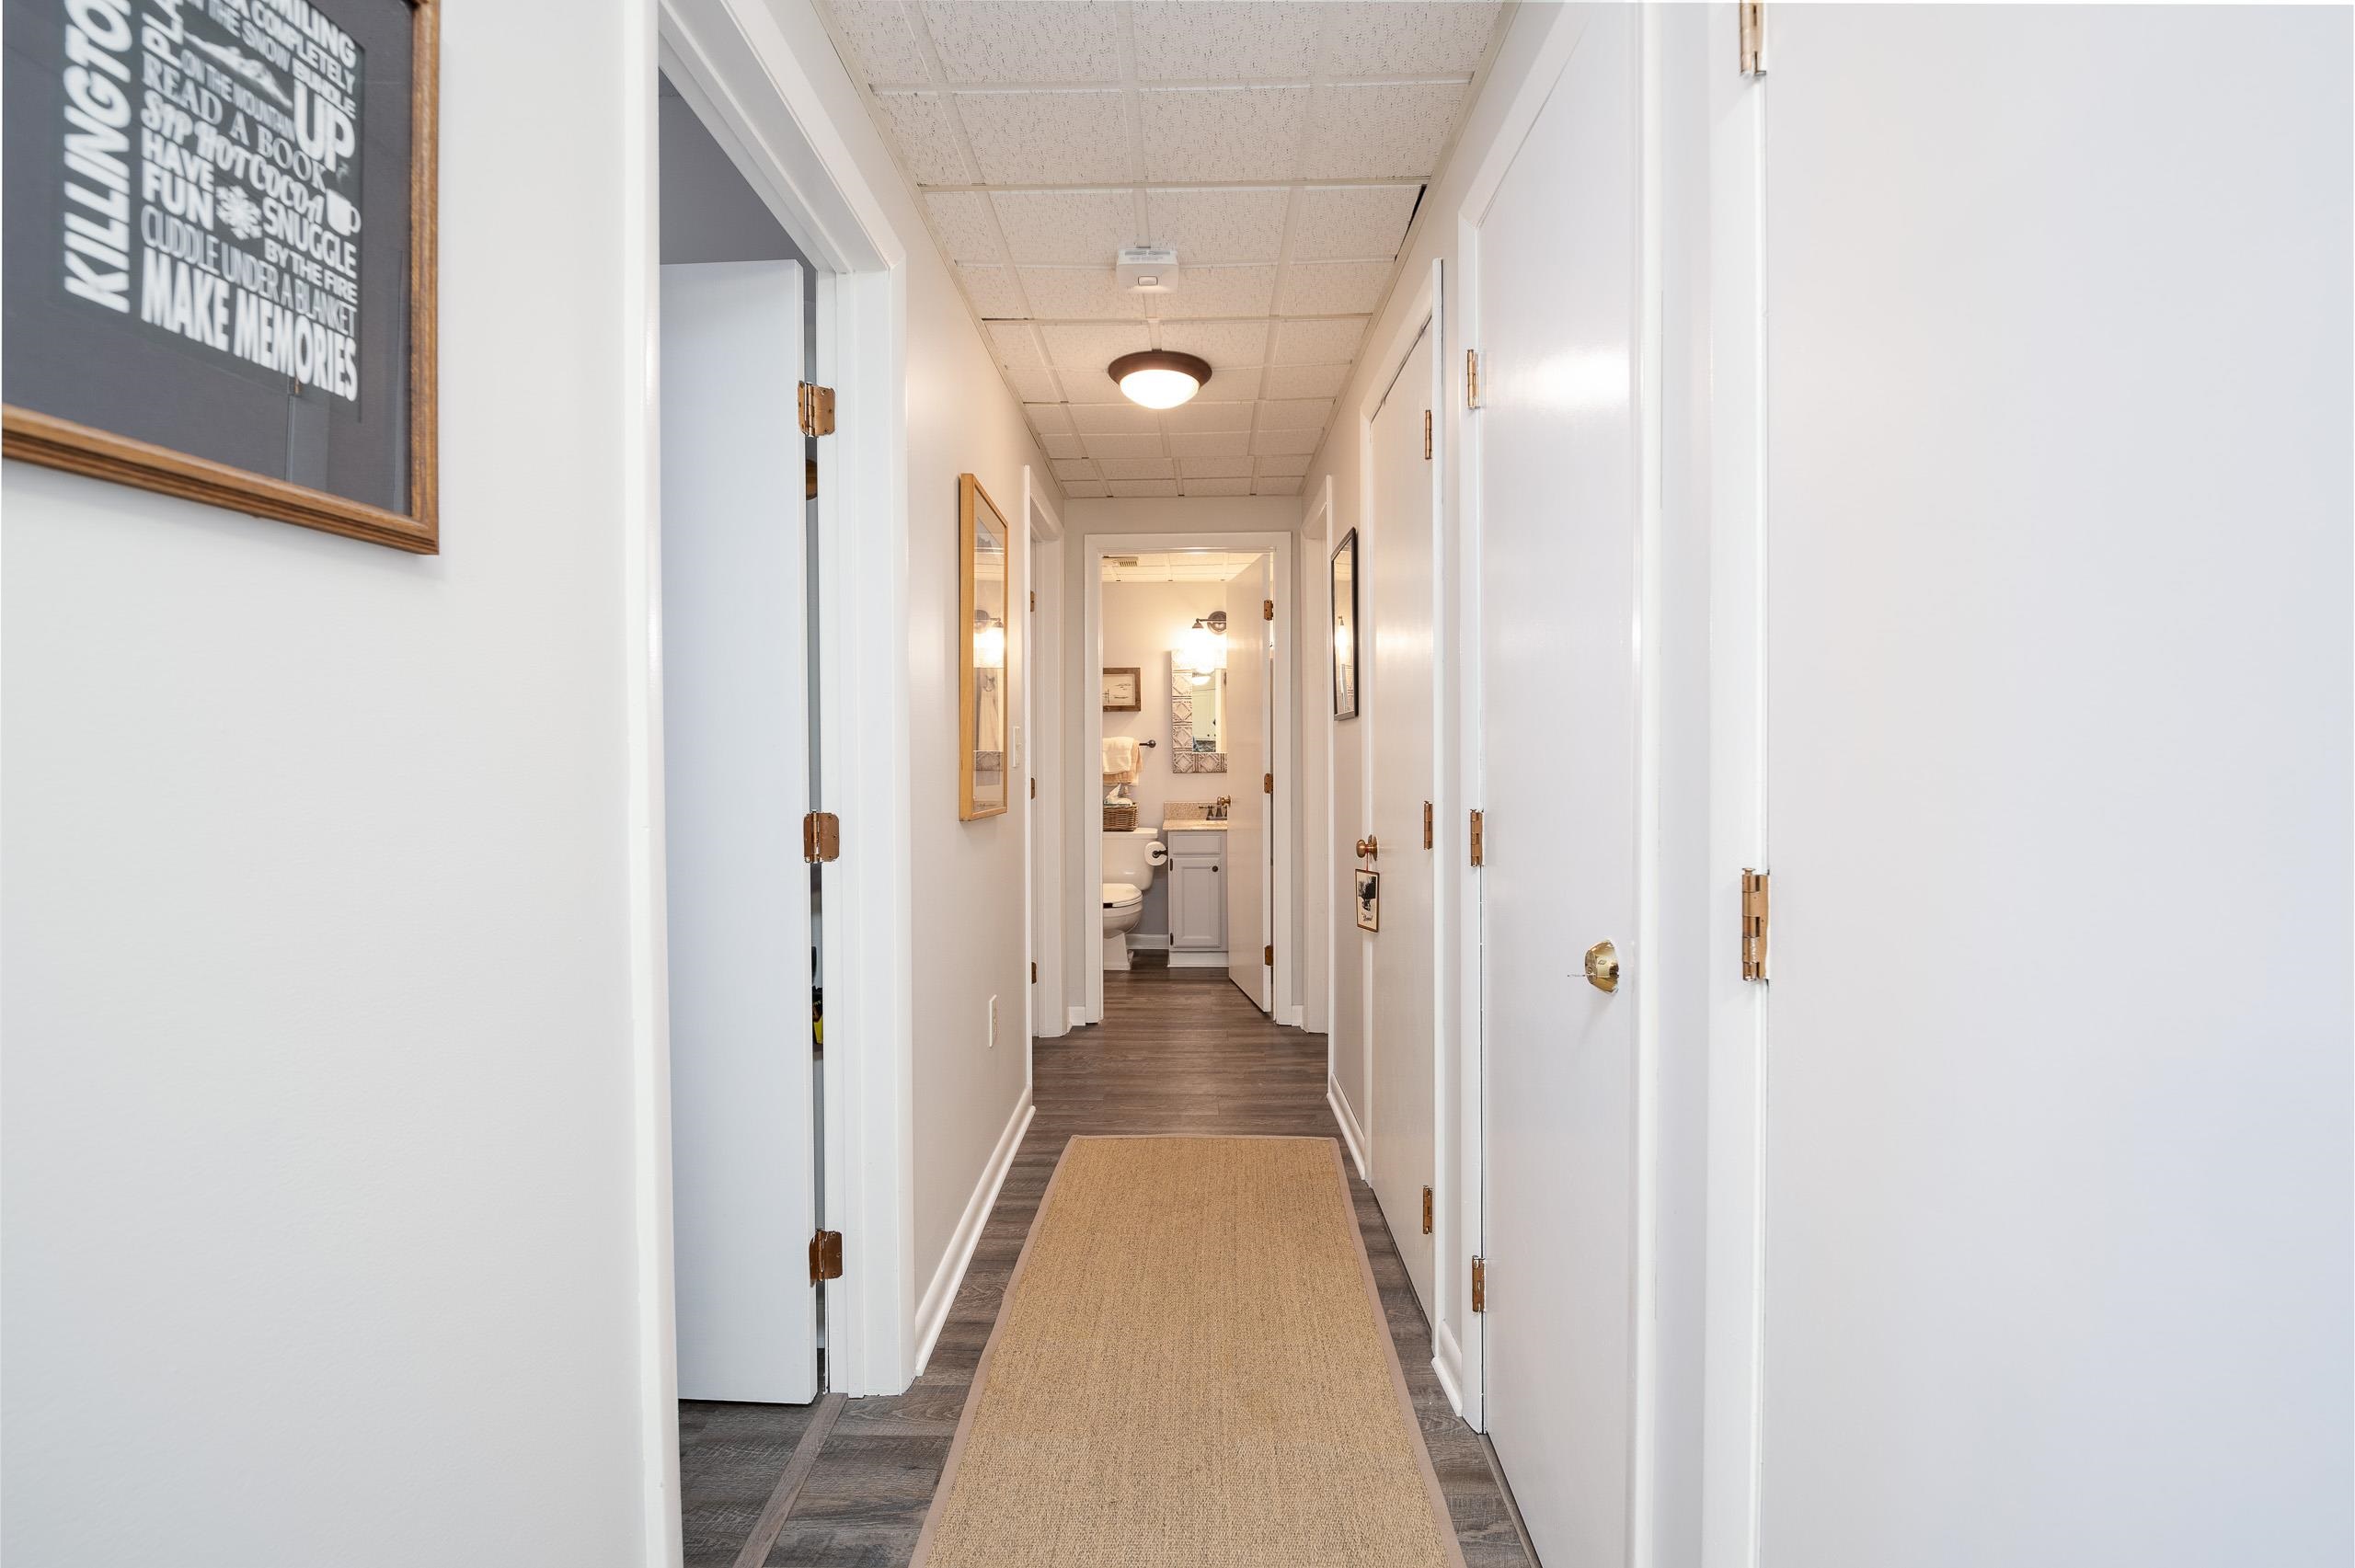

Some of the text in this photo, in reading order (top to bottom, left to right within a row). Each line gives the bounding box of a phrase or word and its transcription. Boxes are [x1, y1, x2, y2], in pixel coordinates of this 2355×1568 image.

[241, 18, 291, 73] SNOW
[250, 0, 356, 95] COMPLETELY
[292, 56, 357, 120] BUNDLE
[142, 50, 327, 194] READ A BOOK
[180, 48, 295, 144] ON THE MOUNTAIN
[293, 77, 356, 173] UP
[63, 0, 133, 314] KILLINGTO
[140, 89, 326, 225] SIP HOT COCOA
[141, 126, 214, 194] HAVE
[142, 160, 214, 232] FUN
[140, 203, 358, 339] CUDDLE UNDER A BLANKET
[261, 196, 357, 280] SNUGGLE
[264, 237, 358, 304] BY THE FIRE
[140, 245, 358, 403] MAKE MEMORIES
